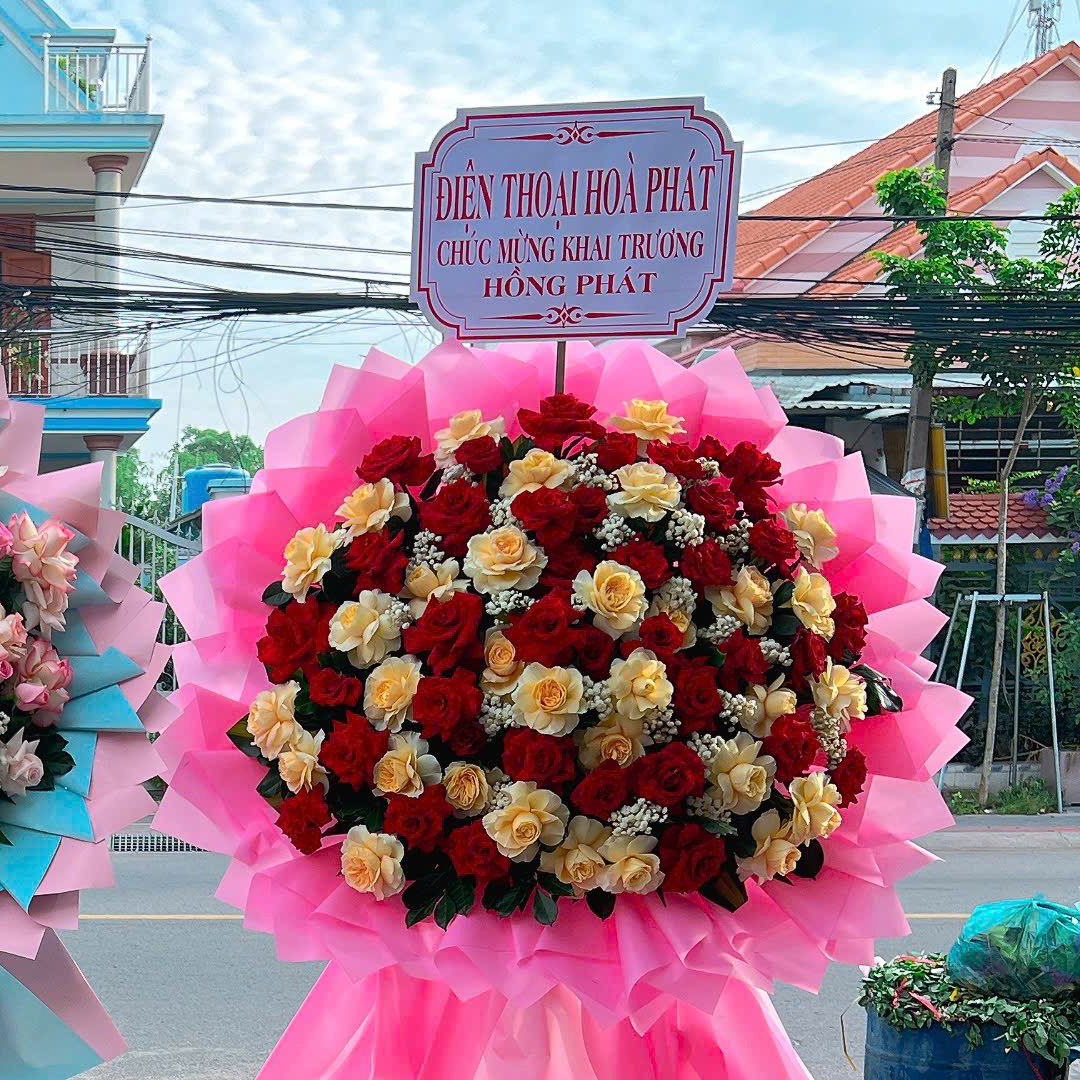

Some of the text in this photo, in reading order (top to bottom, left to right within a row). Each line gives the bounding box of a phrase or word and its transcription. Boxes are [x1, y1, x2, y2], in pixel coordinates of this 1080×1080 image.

[434, 148, 716, 233] ĐIỆN THOẠI HOÀ PHÁT
[437, 228, 705, 267] CHÚC MỪNG KHAI TRƯƠNG
[483, 266, 658, 298] HỒNG PHÁT
